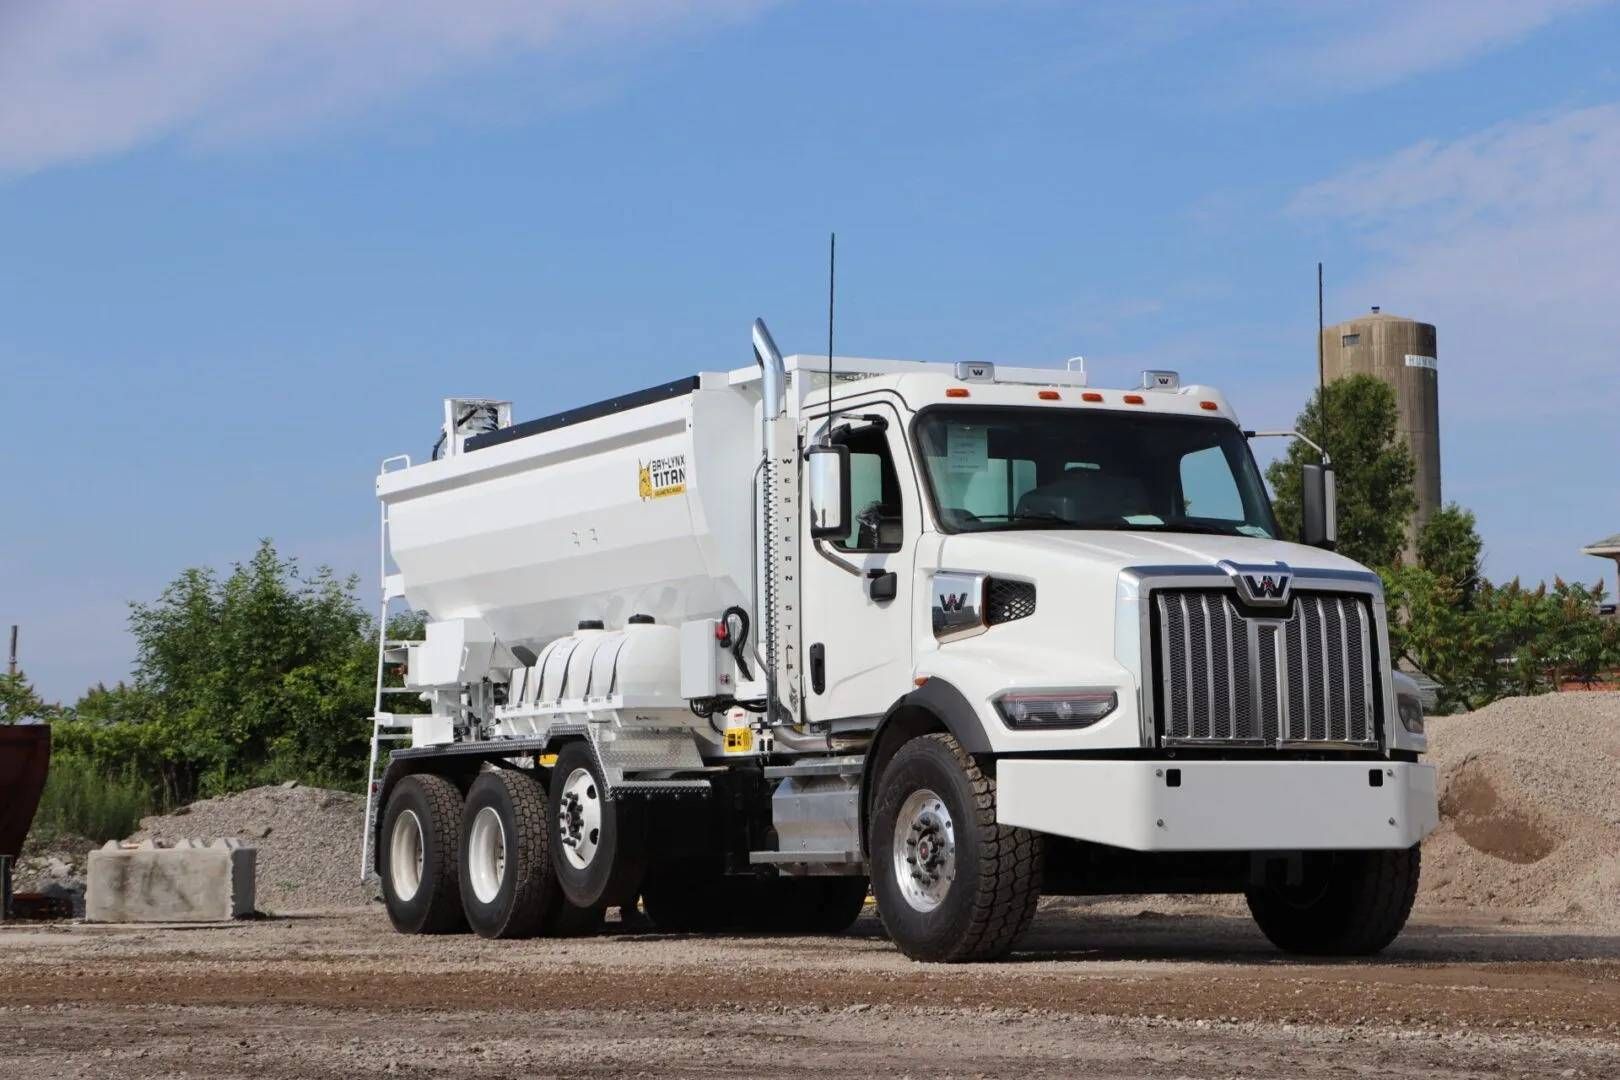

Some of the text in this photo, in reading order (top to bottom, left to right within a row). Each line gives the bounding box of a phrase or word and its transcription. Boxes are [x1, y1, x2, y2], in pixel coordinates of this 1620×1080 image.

[652, 454, 685, 472] BAY-LYNX
[653, 468, 685, 487] TITAN
[783, 458, 793, 581] WESTERN
